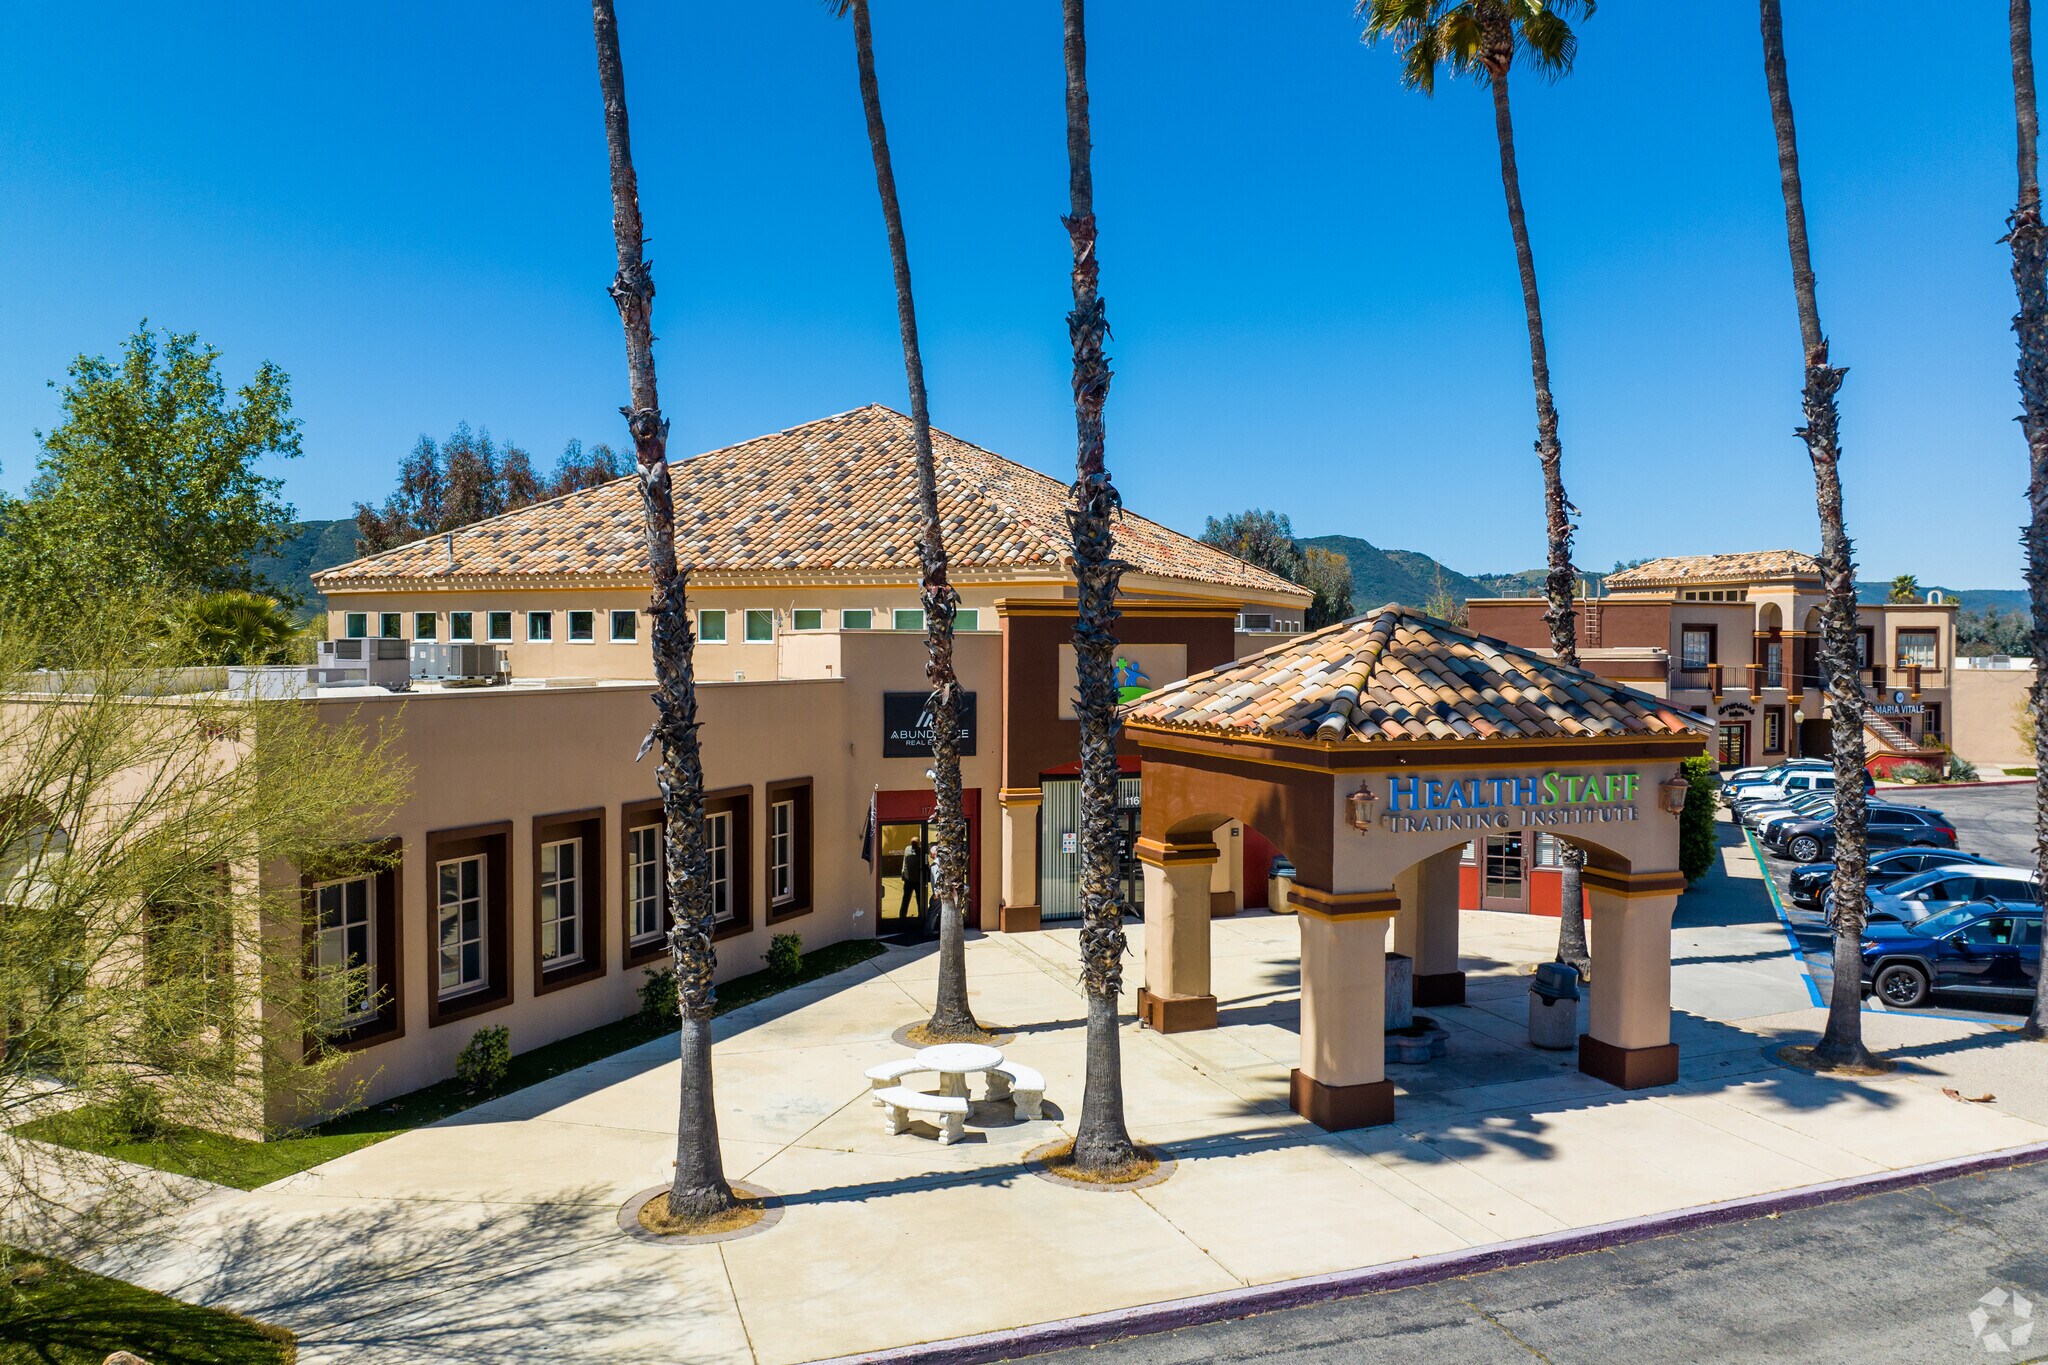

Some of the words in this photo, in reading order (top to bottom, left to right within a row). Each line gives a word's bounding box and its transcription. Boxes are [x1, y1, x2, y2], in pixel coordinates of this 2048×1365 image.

[1875, 705, 1899, 714] MARIA
[1901, 705, 1925, 714] VITALE
[890, 729, 969, 739] ABUNDE
[1125, 796, 1140, 806] 116
[1388, 812, 1509, 833] TRAINING
[1520, 806, 1639, 826] INSTITUTE
